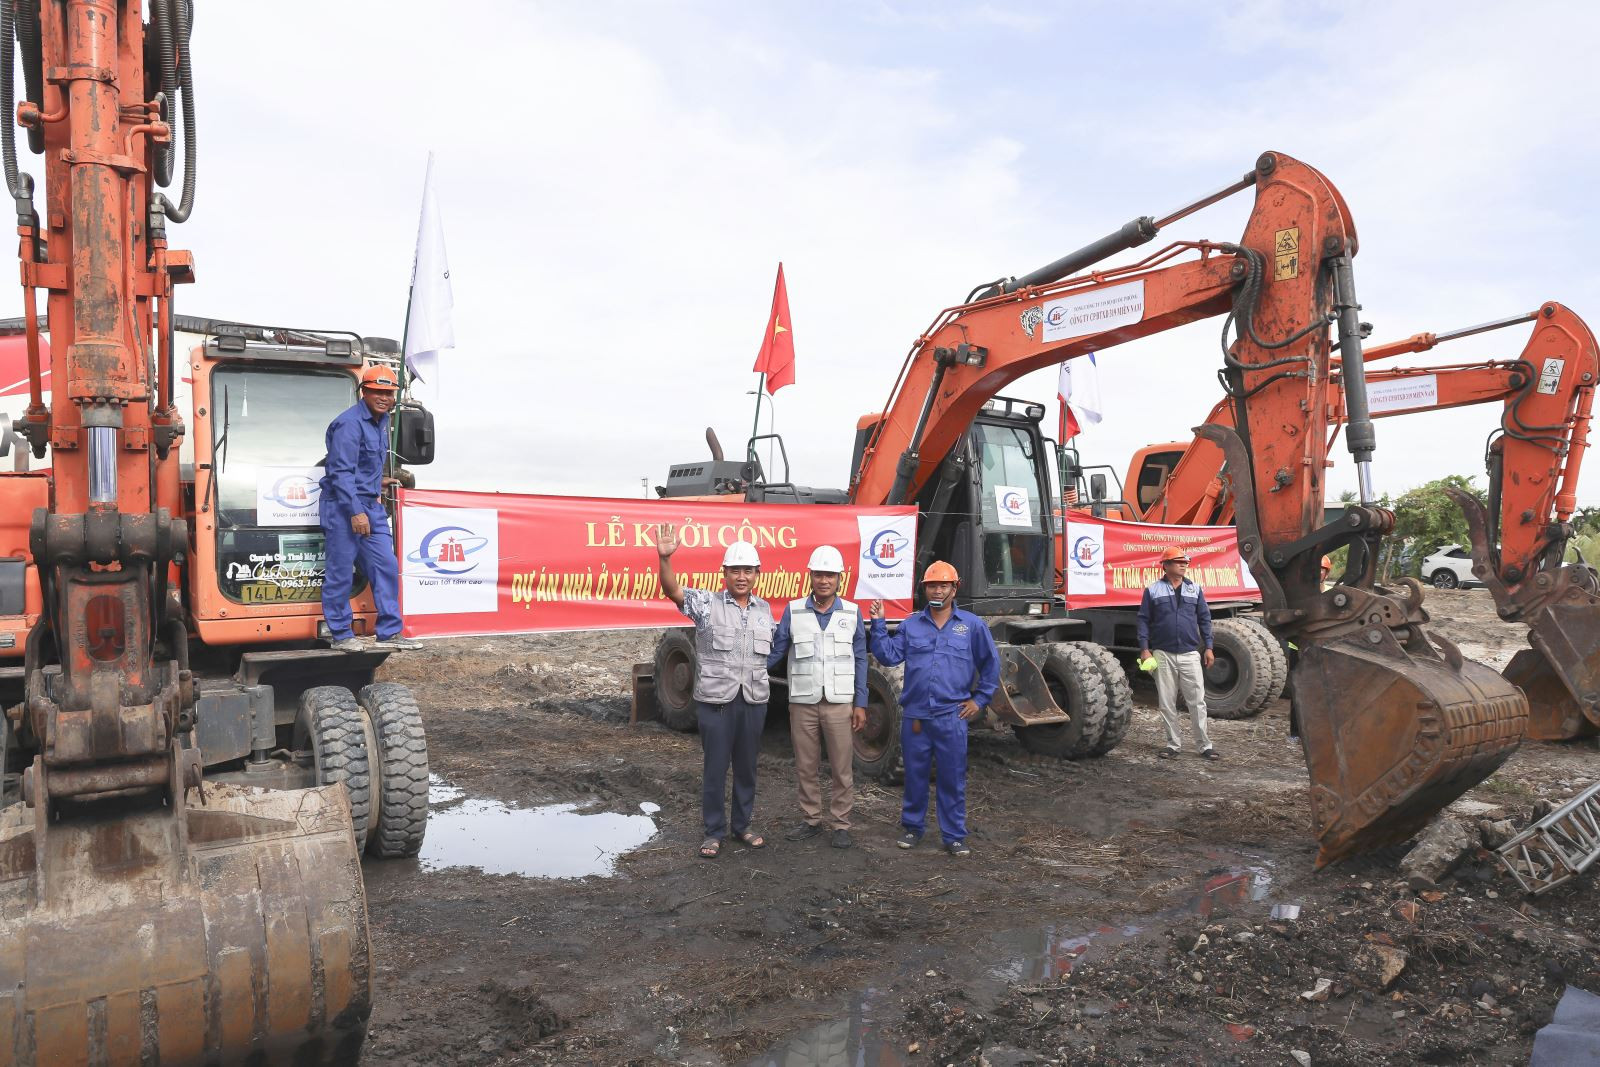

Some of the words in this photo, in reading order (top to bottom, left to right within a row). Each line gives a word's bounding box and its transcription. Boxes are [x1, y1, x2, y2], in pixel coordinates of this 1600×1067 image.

[585, 515, 626, 547] LỄ
[717, 518, 798, 549] CÔNG
[511, 571, 536, 609] DỰ
[536, 567, 560, 602] ÁN
[561, 567, 592, 601] NHÀ
[595, 563, 609, 600] Ở
[608, 567, 630, 600] XÃ
[631, 567, 658, 607] HỘI
